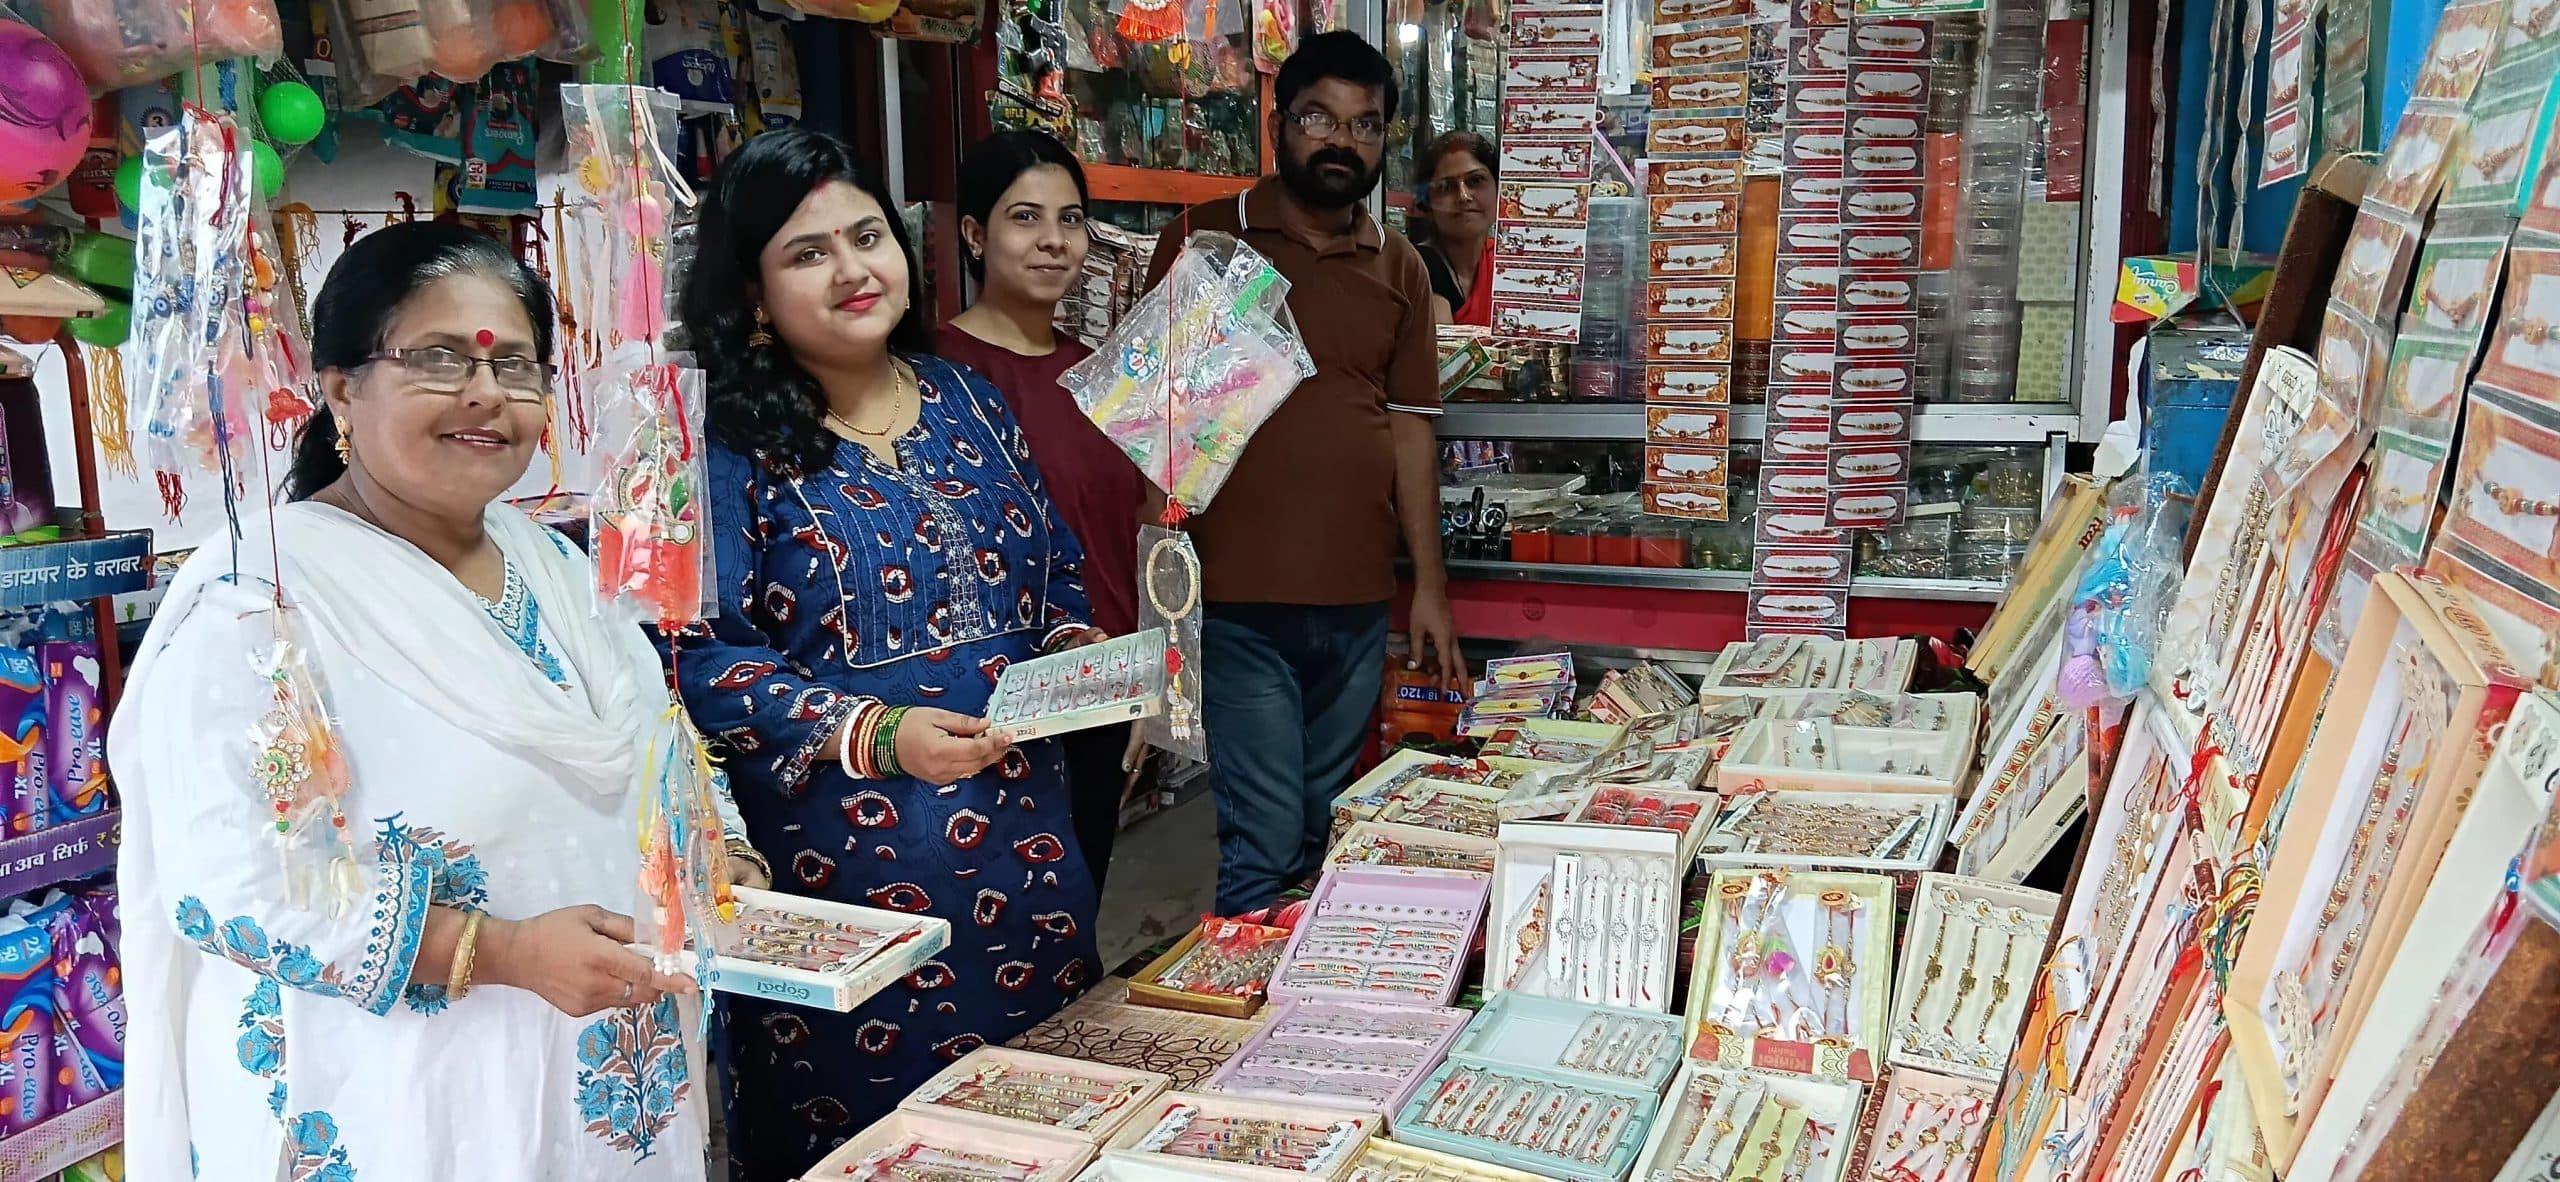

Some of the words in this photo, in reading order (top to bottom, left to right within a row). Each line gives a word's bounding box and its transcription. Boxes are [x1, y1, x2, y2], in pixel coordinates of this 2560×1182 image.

[0, 565, 61, 589] डायपर
[66, 557, 89, 580] के
[1446, 690, 1464, 704] XL
[67, 693, 85, 785] Pro-ease
[87, 736, 102, 760] XL
[14, 775, 28, 800] XL
[32, 750, 47, 831] Pro-eas
[15, 852, 46, 873] अब
[52, 836, 90, 863] सिर्फ
[22, 936, 45, 962] 2X
[756, 980, 811, 1001] Gopal
[20, 1032, 39, 1121] Pro-ease
